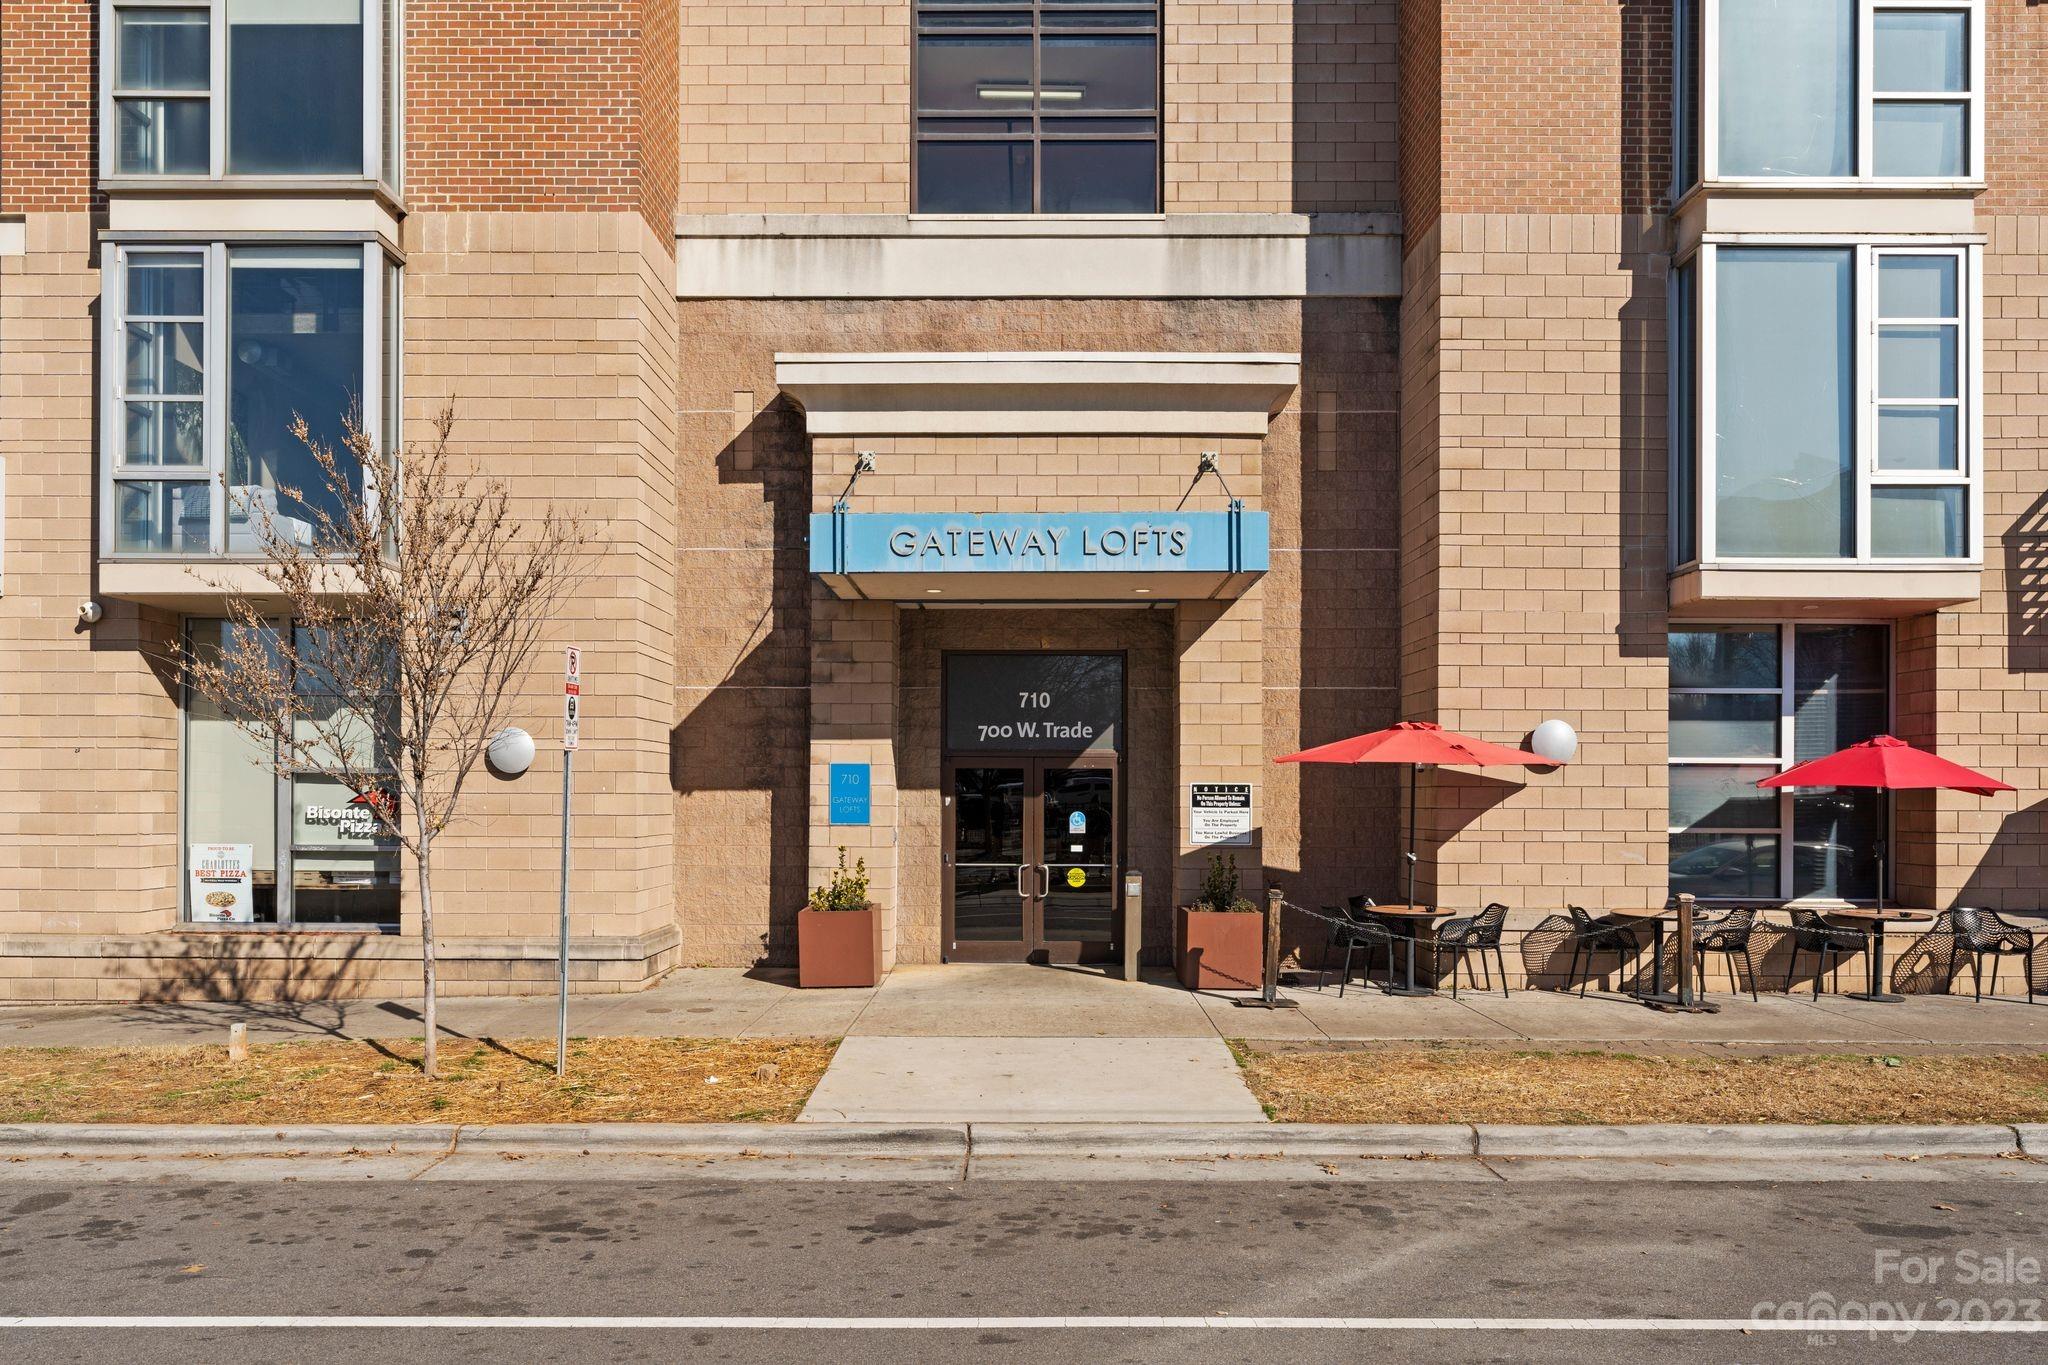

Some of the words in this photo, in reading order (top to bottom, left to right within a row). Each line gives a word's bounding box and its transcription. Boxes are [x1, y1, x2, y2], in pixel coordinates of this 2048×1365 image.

[889, 528, 1067, 557] GATEWAY
[1083, 528, 1187, 557] LOFTS
[1019, 692, 1051, 708] 710
[978, 725, 1013, 741] 700
[1017, 722, 1040, 738] W.
[1043, 721, 1093, 738] Trade
[841, 774, 860, 785] 710
[832, 796, 867, 804] GATEWAY
[306, 805, 370, 819] Bisonte
